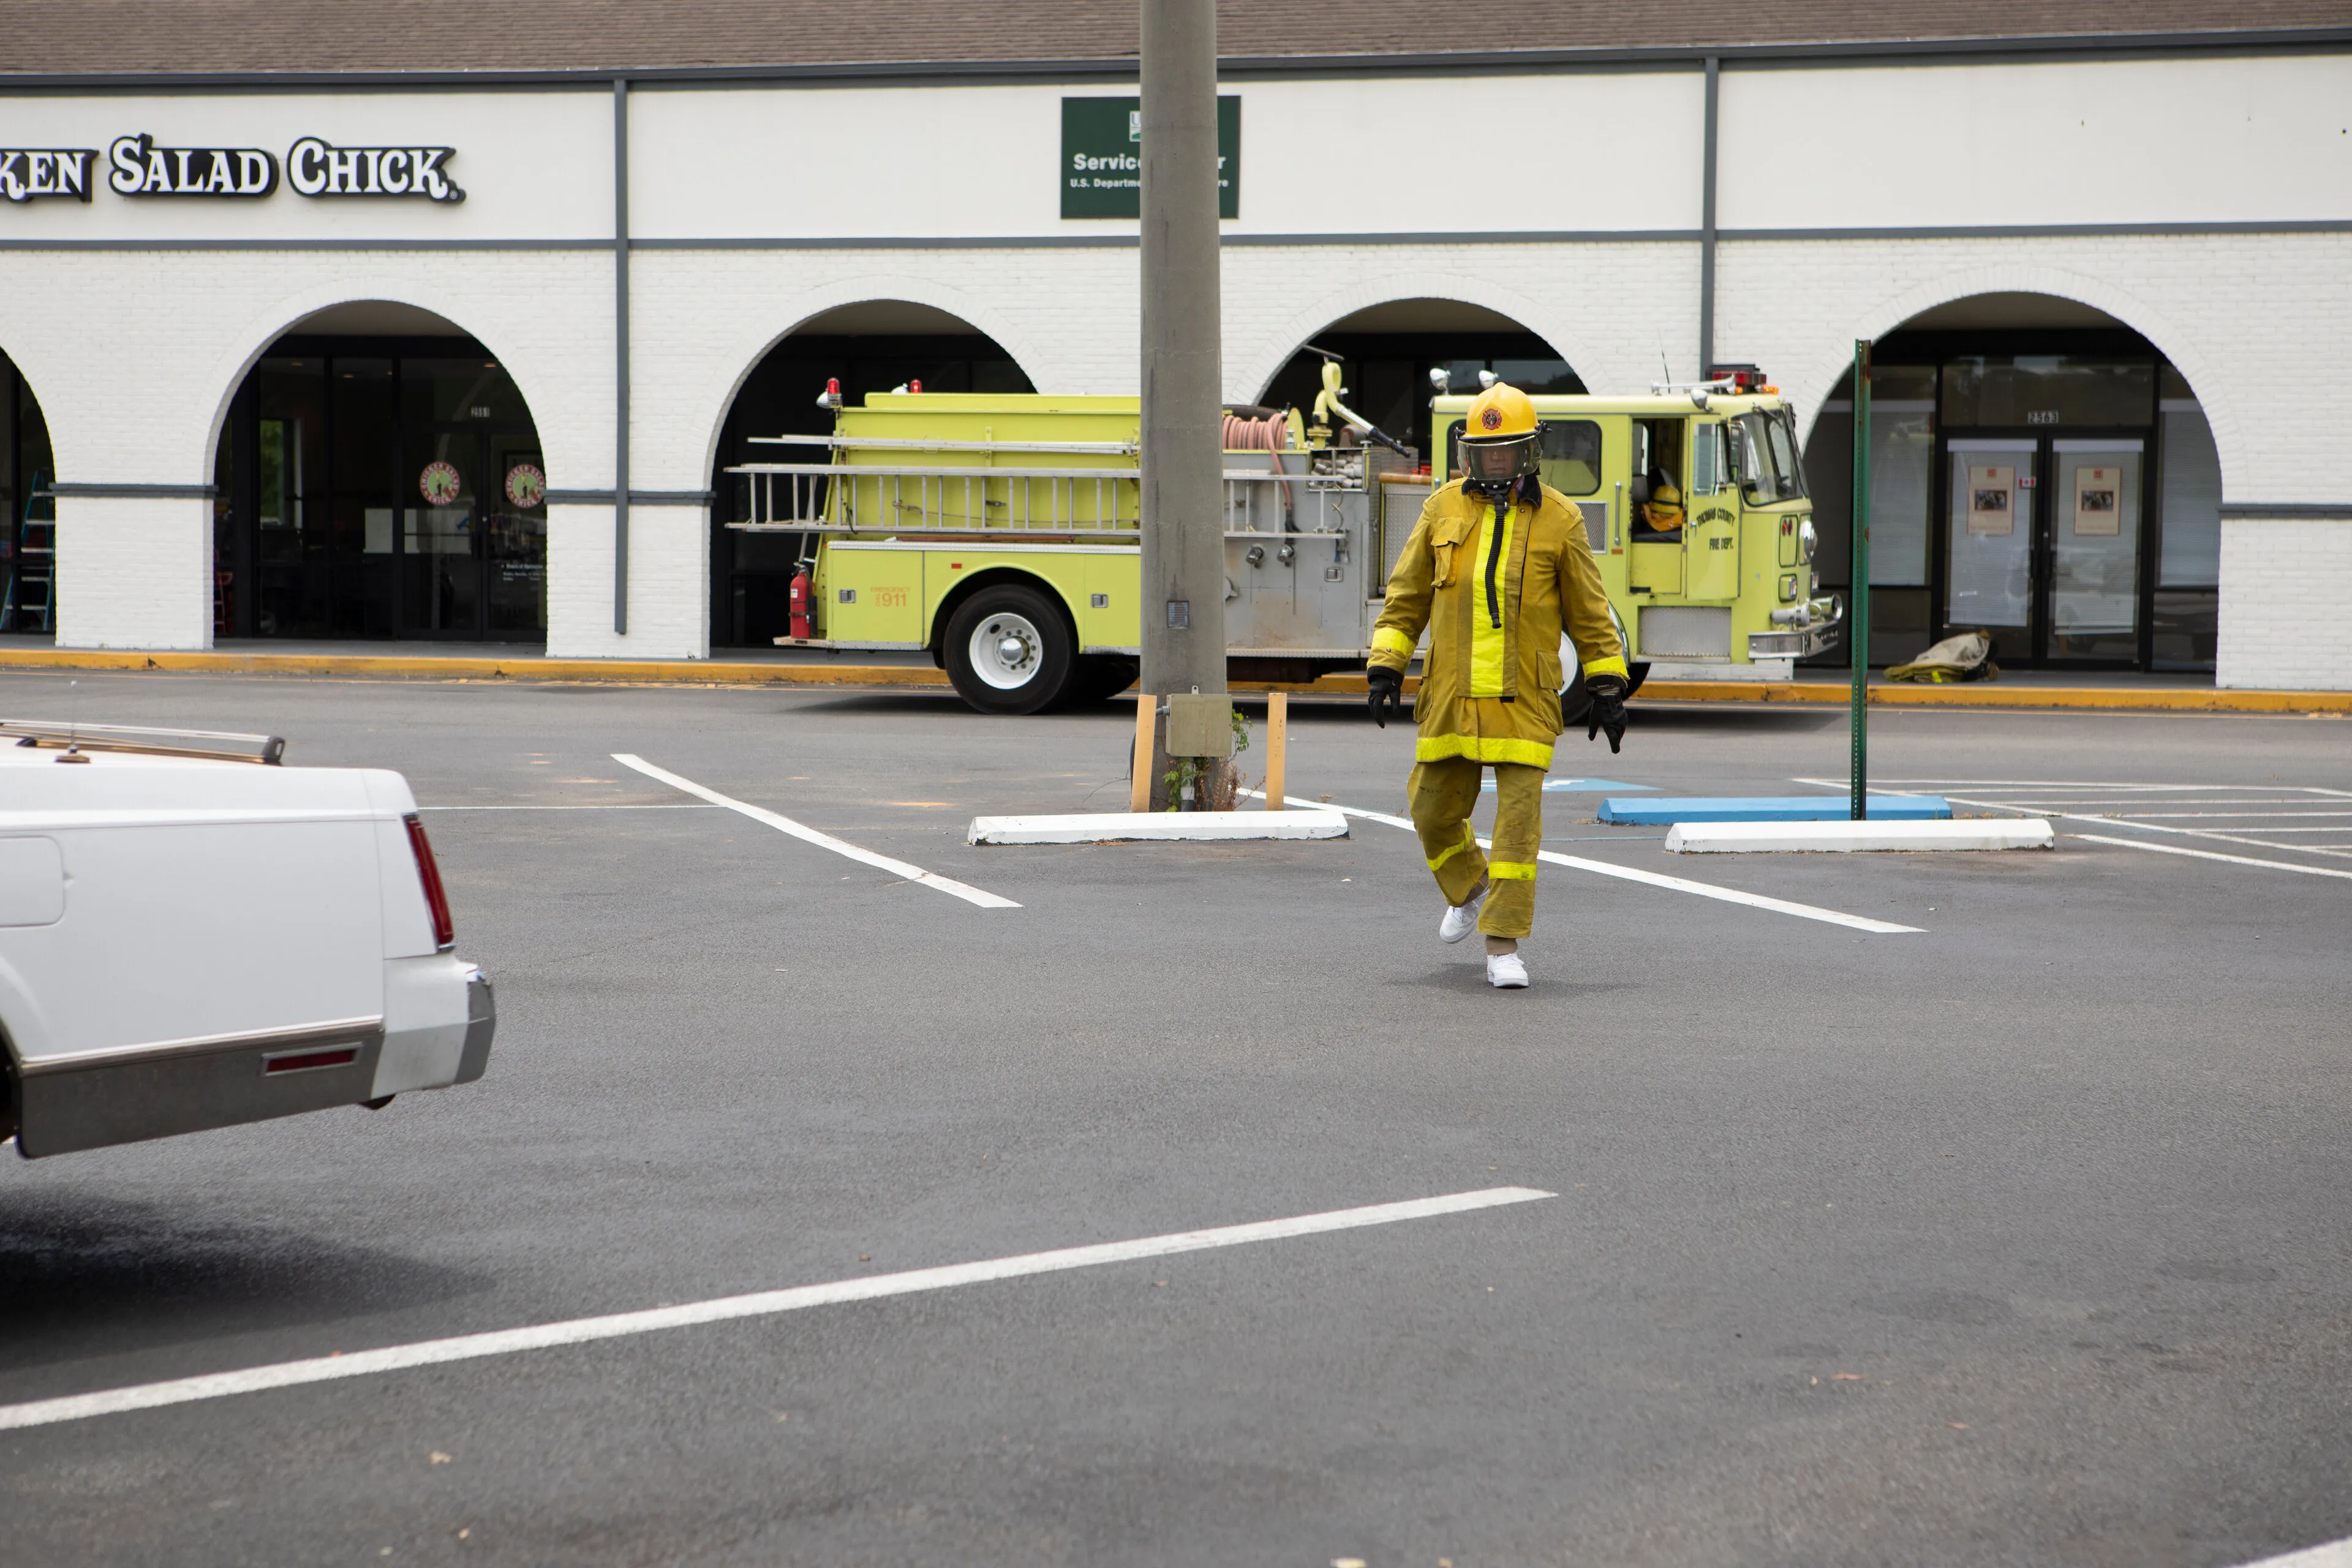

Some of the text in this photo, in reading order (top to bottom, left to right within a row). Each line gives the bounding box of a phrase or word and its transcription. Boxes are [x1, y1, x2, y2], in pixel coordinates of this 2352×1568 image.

[111, 138, 270, 193] SALAD
[290, 139, 448, 199] CHICK
[1070, 178, 1090, 187] U.S.
[2029, 410, 2057, 423] 2563
[1717, 507, 1735, 527] COUNTY
[882, 593, 907, 607] 911
